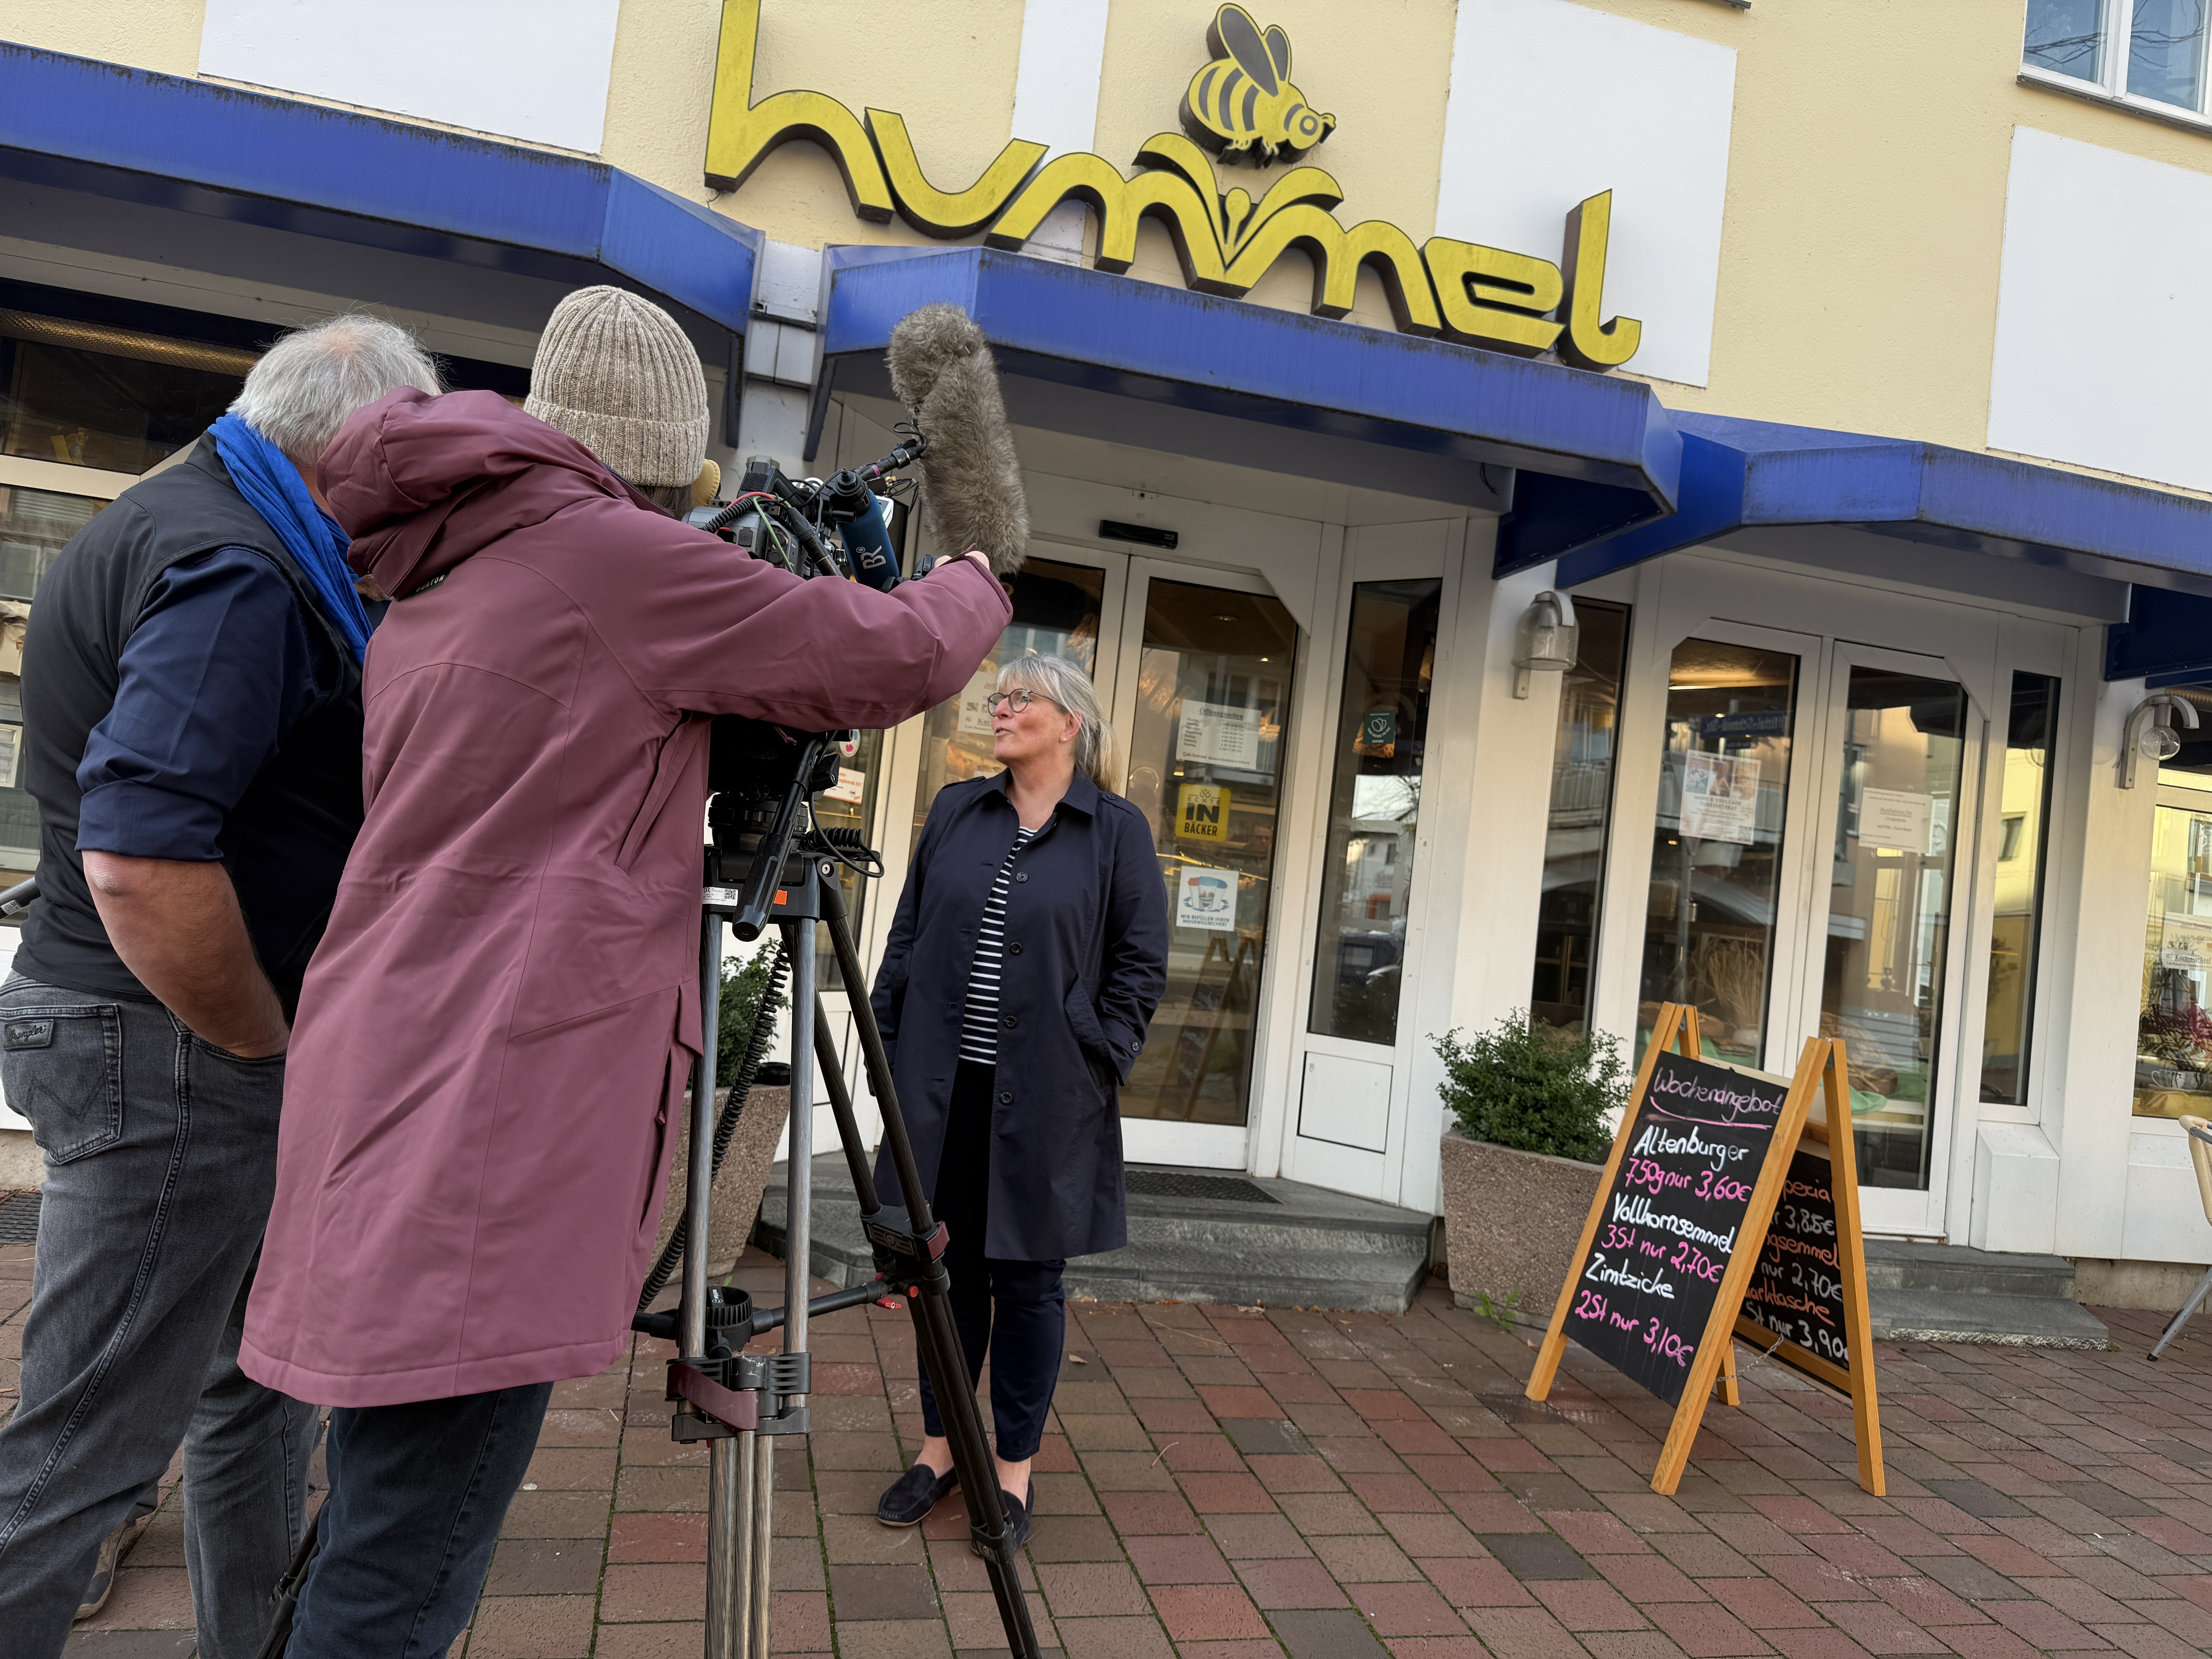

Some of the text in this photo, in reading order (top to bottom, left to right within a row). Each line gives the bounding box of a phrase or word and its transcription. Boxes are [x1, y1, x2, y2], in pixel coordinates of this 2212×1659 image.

[704, 0, 1642, 372] hummel
[860, 545, 886, 569] BR
[1199, 707, 1243, 719] Öffnungszeiten
[1186, 802, 1220, 824] IN
[1188, 797, 1221, 805] ECHTE
[1184, 821, 1218, 836] BÄCKER
[7, 1024, 47, 1043] Wrangler
[1653, 1067, 1783, 1123] Wochenangebot
[1632, 1125, 1750, 1172] Altenburger
[1695, 1171, 1752, 1202] 3,60€
[1612, 1192, 1735, 1254] Vollkornsemmel
[1640, 1240, 1667, 1259] nur
[1670, 1242, 1724, 1283] 2,70€
[1761, 1261, 1784, 1279] nur
[1585, 1252, 1675, 1299] Zimtzicke
[1610, 1311, 1639, 1331] nur
[1643, 1317, 1694, 1367] 3,10€
[1769, 1315, 1793, 1338] nur
